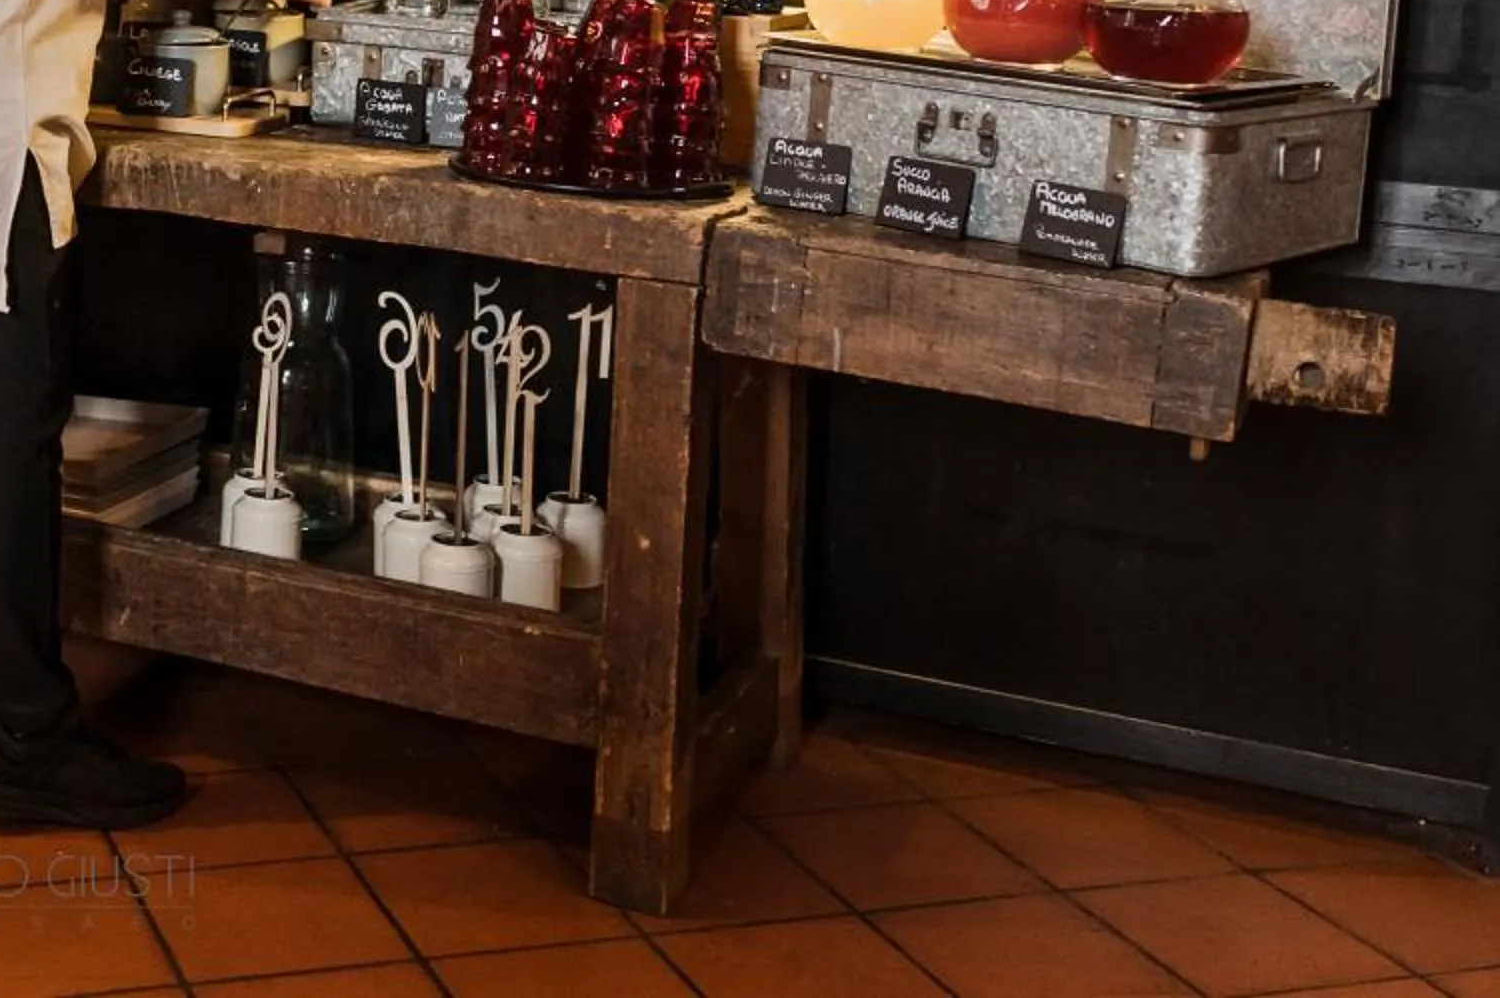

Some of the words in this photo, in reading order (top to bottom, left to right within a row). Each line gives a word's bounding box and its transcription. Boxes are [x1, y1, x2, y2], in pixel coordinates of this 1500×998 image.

[891, 159, 931, 181] SUCCO
[471, 276, 505, 352] 5
[567, 303, 613, 379] 11
[517, 325, 551, 405] 2
